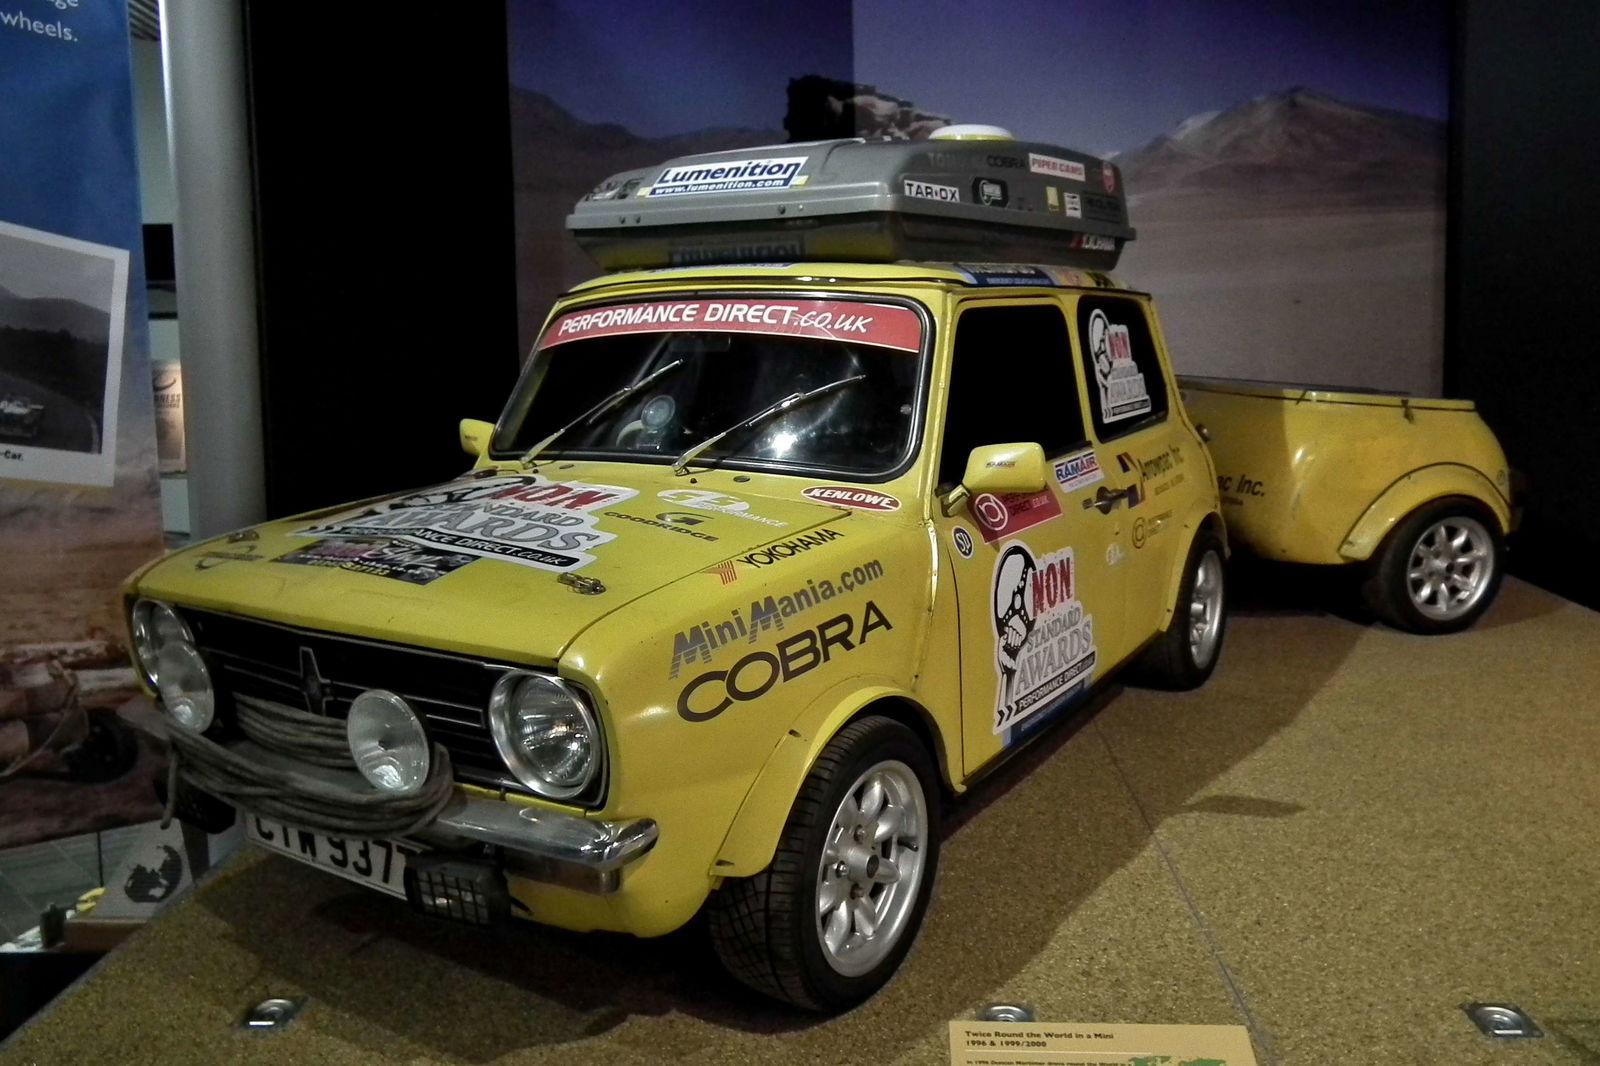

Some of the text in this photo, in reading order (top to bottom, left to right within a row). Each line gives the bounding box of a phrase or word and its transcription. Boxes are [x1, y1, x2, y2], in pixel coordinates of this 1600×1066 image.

[0, 10, 78, 42] wheels.
[655, 179, 784, 195] www.lumenition.com
[656, 161, 801, 184] Lumenition
[558, 303, 699, 336] PERFORMANCE
[1055, 456, 1098, 481] RAMAIR
[810, 487, 894, 508] KENLOWE
[1236, 474, 1265, 497] Inc.
[736, 528, 845, 568] YOKOHAMA
[1031, 556, 1073, 619] NON
[1027, 606, 1081, 652] STANDARD
[677, 600, 893, 723] COBRA
[1016, 620, 1092, 696] AWARDS
